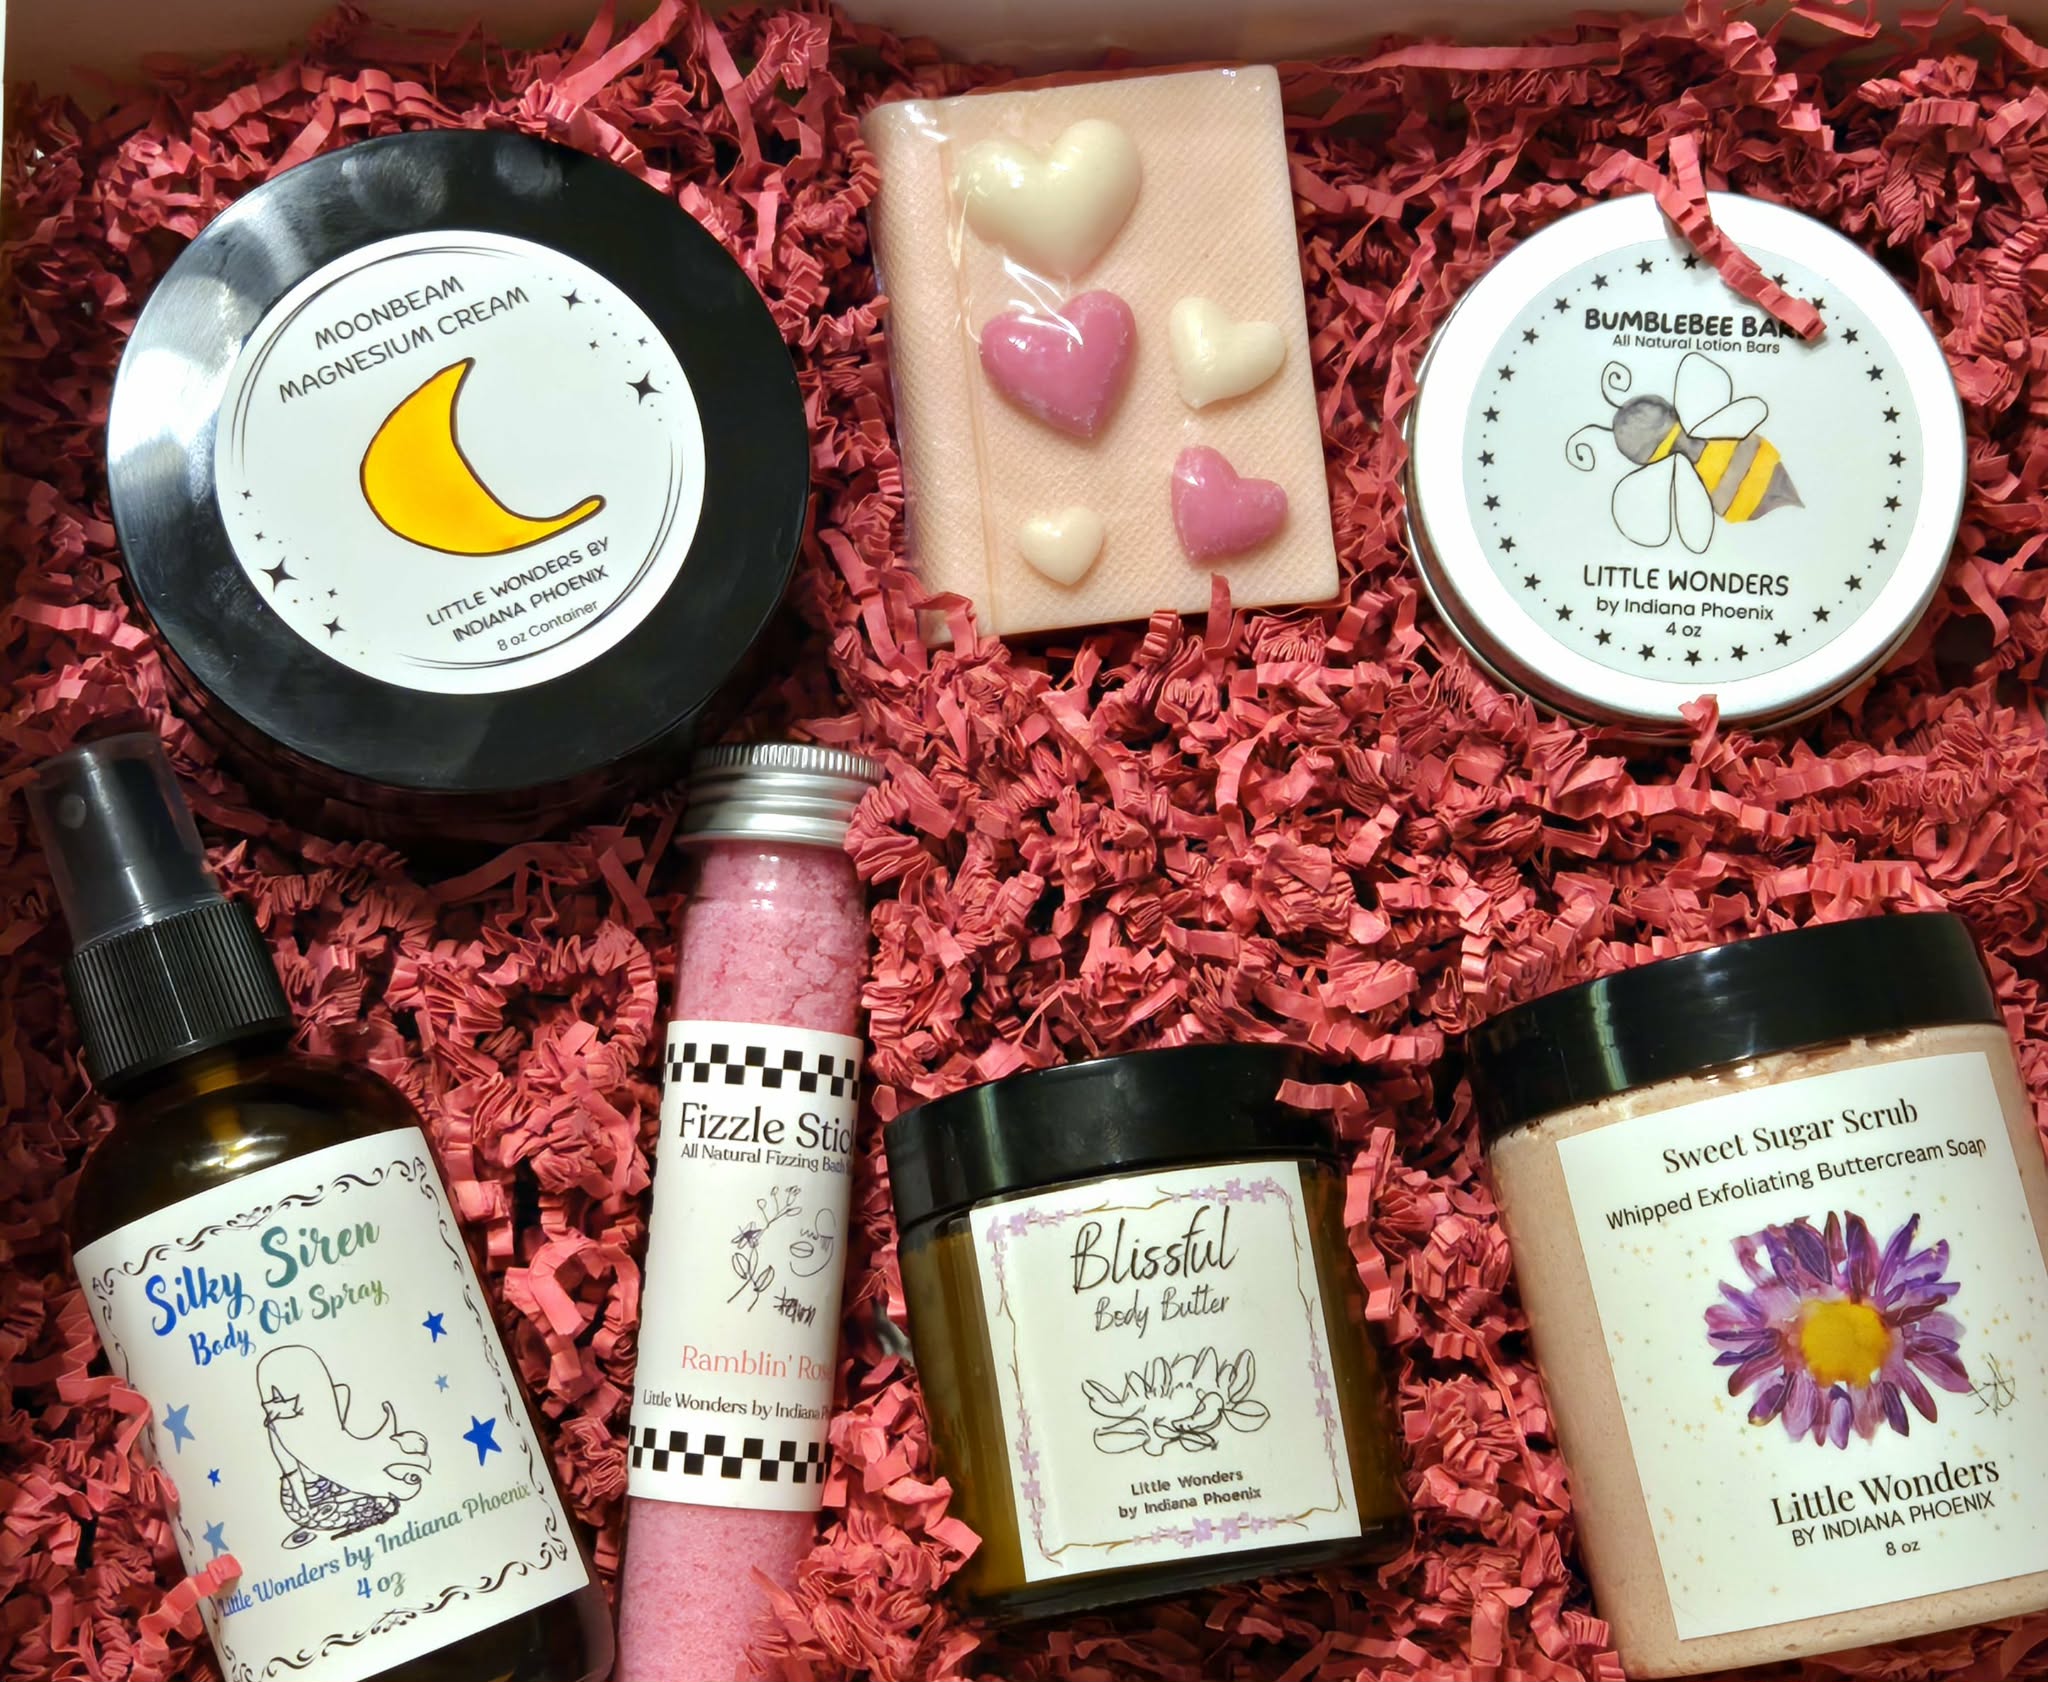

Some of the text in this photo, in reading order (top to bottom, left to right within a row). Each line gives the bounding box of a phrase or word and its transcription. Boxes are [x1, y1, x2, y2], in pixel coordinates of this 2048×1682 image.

[314, 275, 465, 350] MOONBEAM
[1584, 308, 1733, 337] BUMBLEBEE
[278, 286, 530, 403] MAGNESIUM CREAM
[1612, 334, 1780, 354] All Natural Lotion Bars
[426, 536, 609, 626] LITTLE WONDERS BY
[452, 565, 609, 642] INDIANA PHOENIX
[1583, 565, 1789, 596] LITTLE WONDERS
[497, 601, 598, 651] 8 oz Container
[1596, 597, 1774, 621] by Indiana Phoenix
[1665, 622, 1702, 637] 4 oz
[679, 1102, 785, 1145] Fizzle
[1662, 1098, 1918, 1174] Sweet Sugar Scrub
[681, 1143, 698, 1160] All
[701, 1144, 761, 1164] Natural
[766, 1149, 819, 1173] Fizzing
[1606, 1138, 1987, 1230] Whipped Exfoliating Buttercream Soap
[1070, 1205, 1240, 1294] Blissful
[145, 1221, 380, 1337] Silky Siren
[189, 1280, 389, 1366] Body Oil Spray
[1095, 1284, 1230, 1339] Body Butter
[681, 1345, 793, 1378] Ramblin'
[643, 1389, 672, 1408] Little
[675, 1392, 747, 1416] Wonders
[751, 1400, 773, 1421] by
[775, 1402, 820, 1420] Indiana
[1119, 1486, 1262, 1520] by Indiana Phoenix
[1131, 1470, 1243, 1496] Little Wonders
[1771, 1460, 2000, 1527] Little Wonders
[252, 1558, 340, 1603] Wonders
[344, 1546, 374, 1571] by
[375, 1510, 463, 1554] Indiana
[462, 1481, 532, 1519] Phoenix
[1792, 1491, 1996, 1547] BY INDIANA PHOENIX
[1886, 1540, 1921, 1556] 8 oz
[357, 1571, 406, 1599] 4 oz
